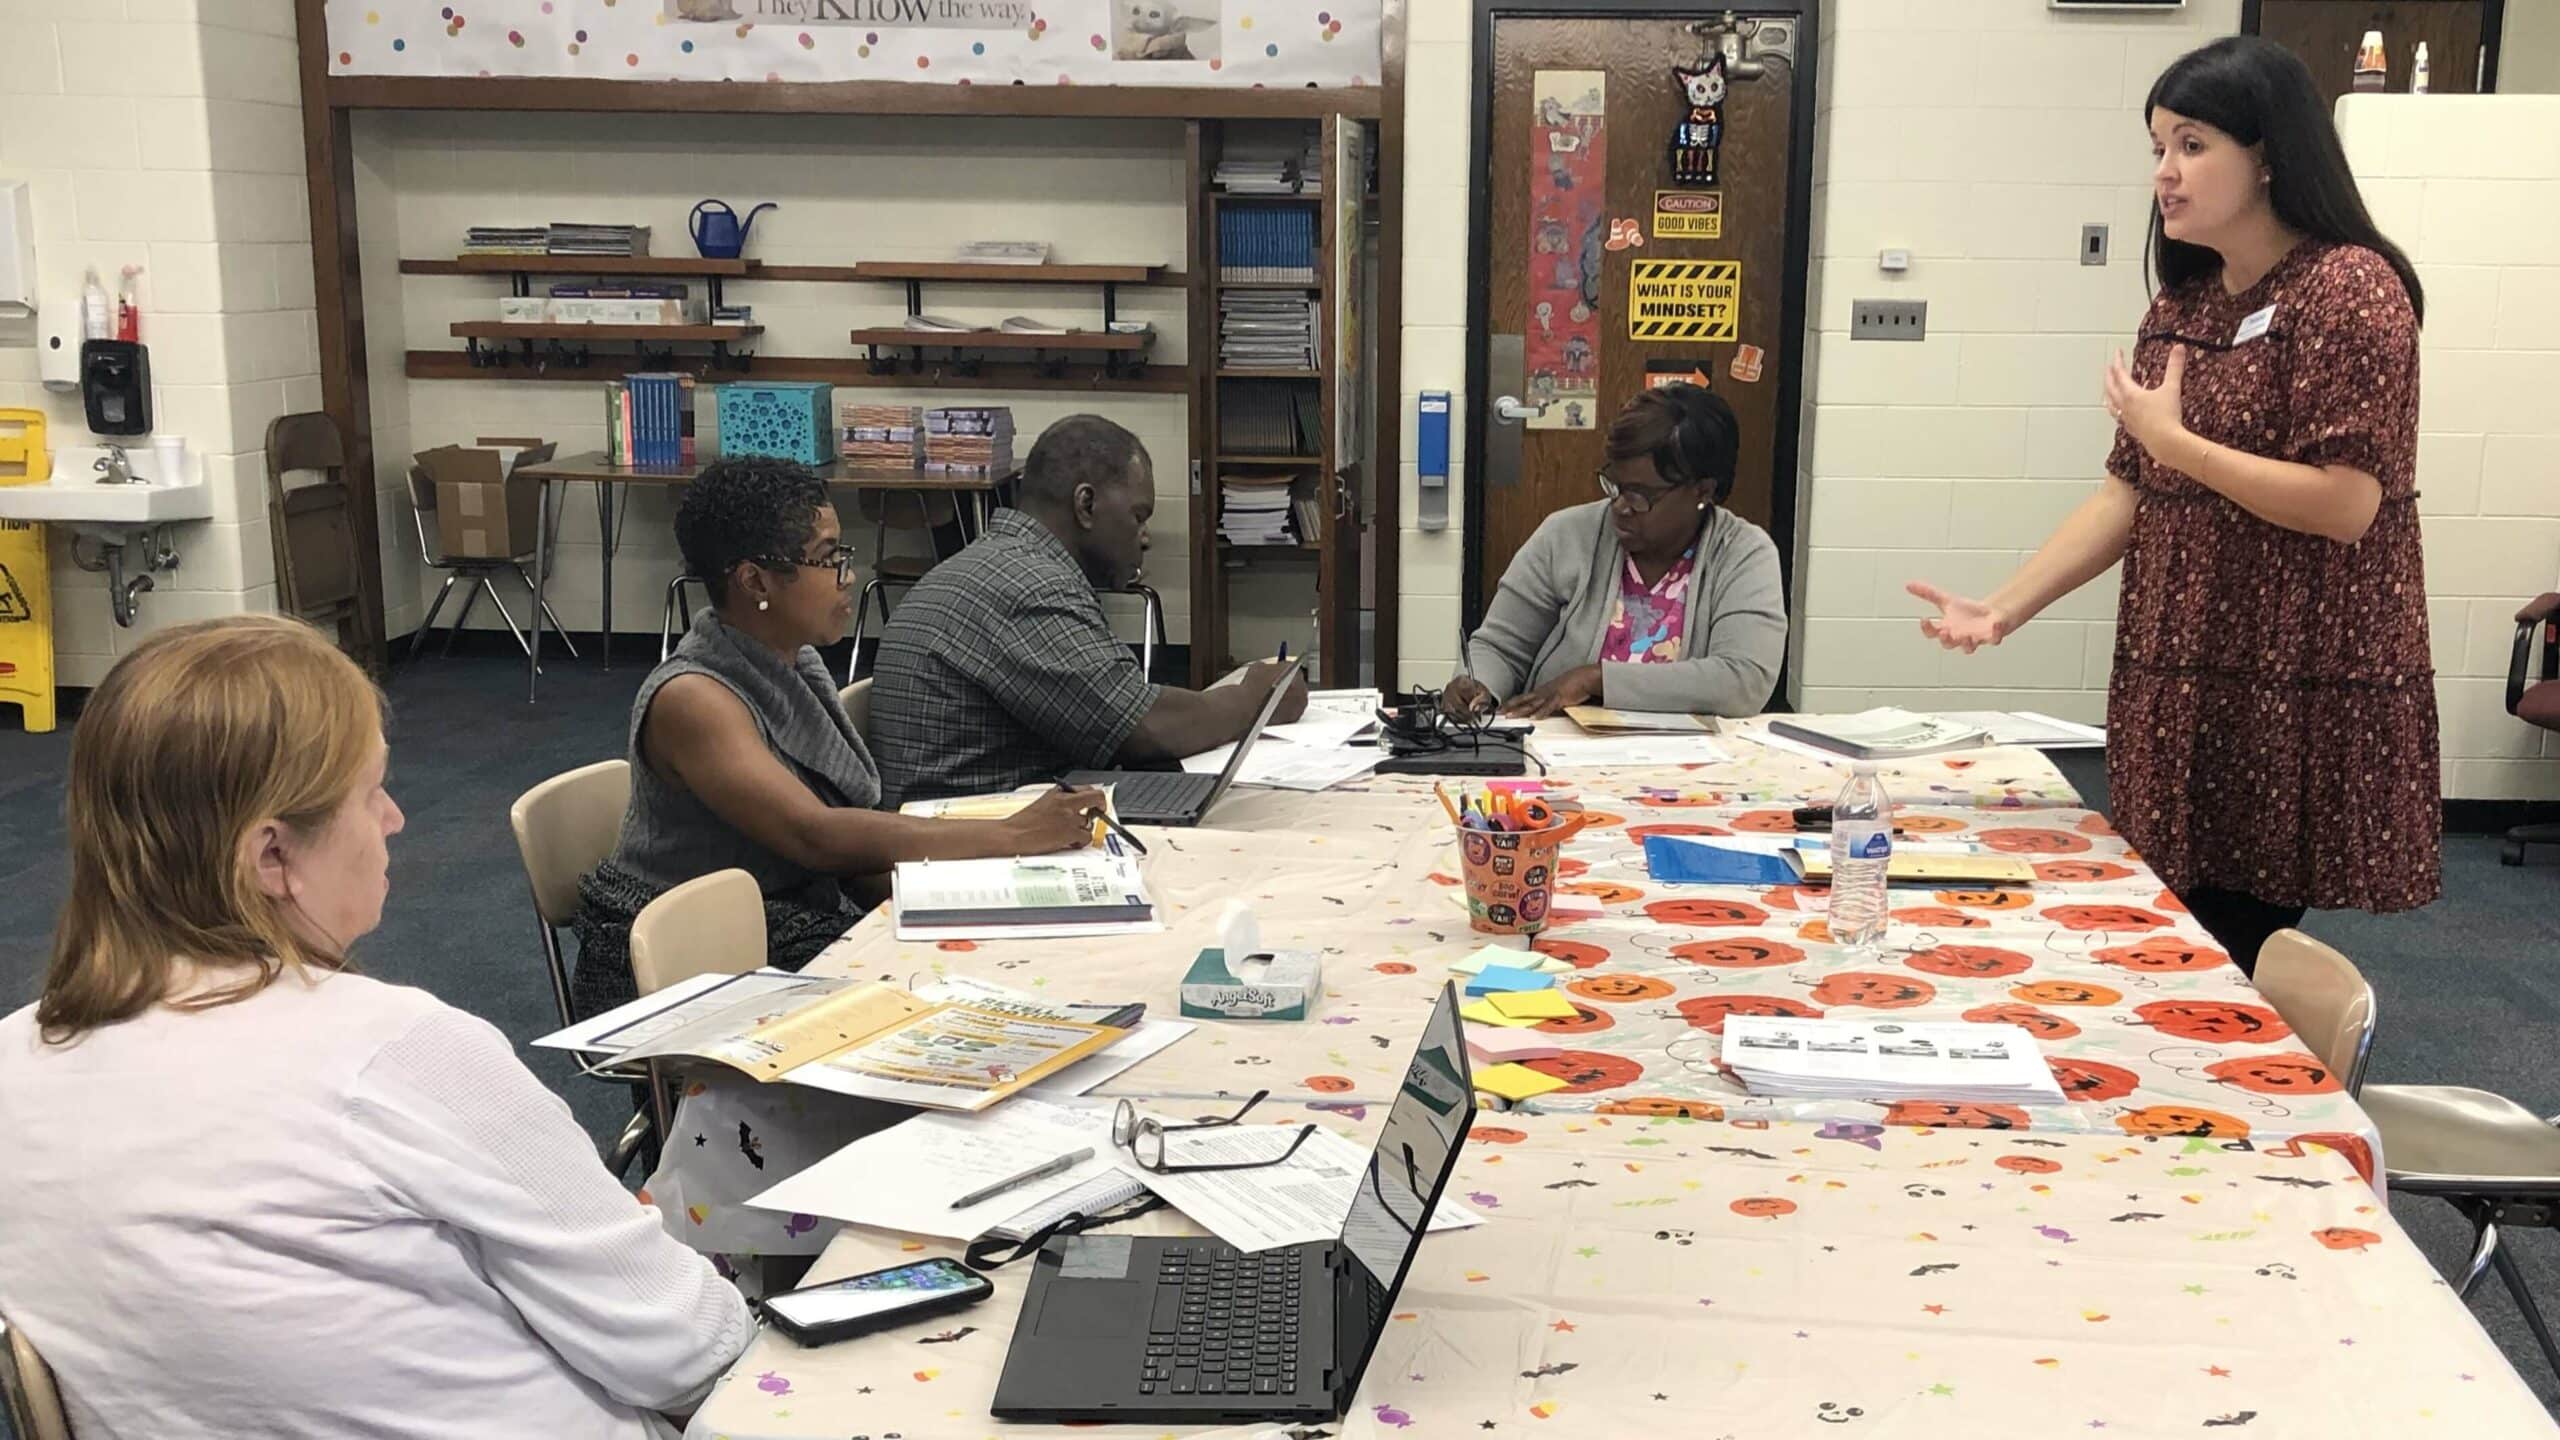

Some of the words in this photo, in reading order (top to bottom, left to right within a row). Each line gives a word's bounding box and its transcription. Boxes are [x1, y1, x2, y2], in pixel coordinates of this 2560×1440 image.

[812, 0, 932, 22] Know
[938, 0, 973, 19] the
[979, 2, 1025, 26] way.
[1664, 198, 1712, 210] CAUTION
[1657, 216, 1686, 230] GOOD
[1687, 217, 1718, 231] VIBES
[1636, 283, 1677, 298] WHAT
[1680, 284, 1694, 298] IS
[1696, 285, 1733, 299] YOUR
[1639, 302, 1727, 318] MINDSET?
